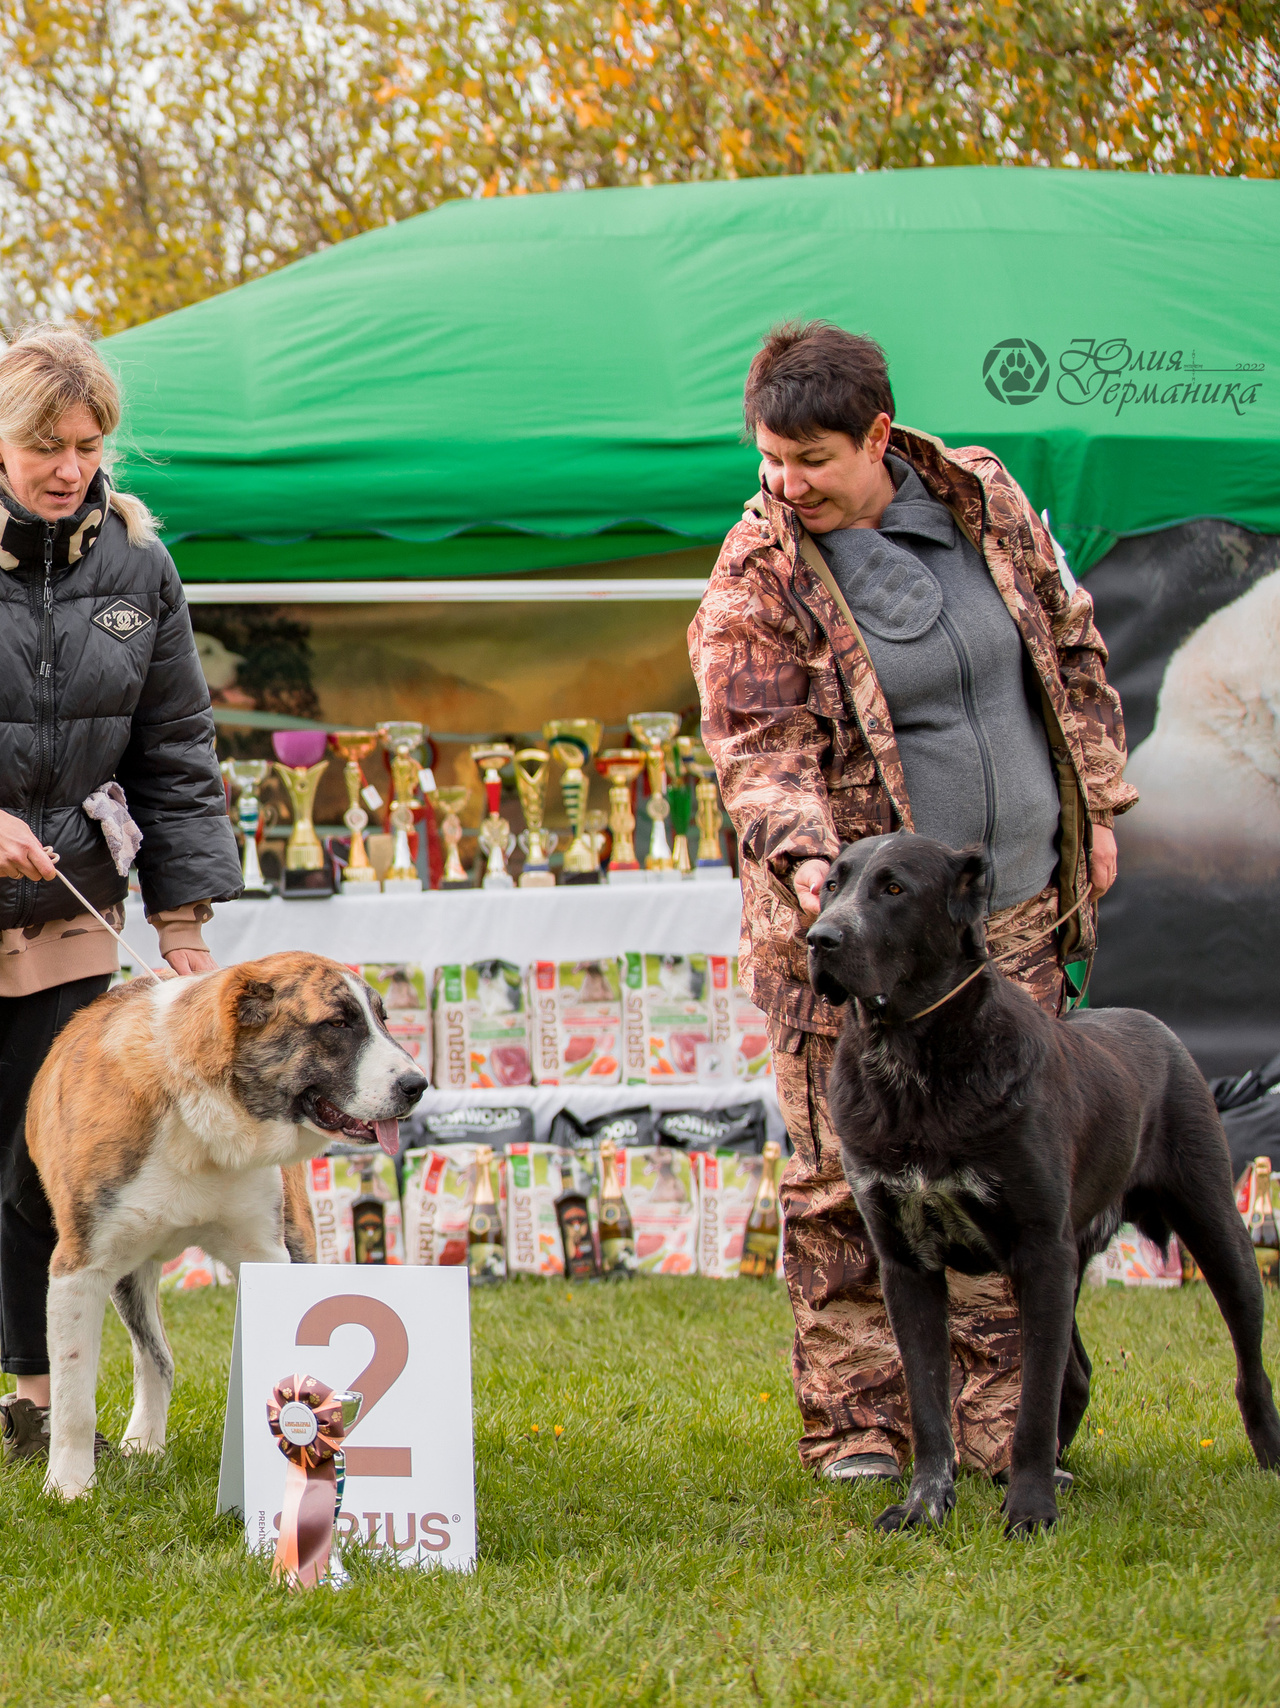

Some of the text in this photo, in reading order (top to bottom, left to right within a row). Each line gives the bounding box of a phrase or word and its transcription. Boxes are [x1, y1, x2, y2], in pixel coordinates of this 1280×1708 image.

[447, 1010, 466, 1084] SIRIUS
[540, 998, 559, 1070] SIRIUS
[626, 997, 644, 1069] SIRIUS
[714, 997, 730, 1043] RIUS
[514, 1195, 535, 1264] SIRIUS
[703, 1197, 719, 1267] SIRIUS
[295, 1293, 412, 1478] 2
[272, 1511, 451, 1552] RIUS
